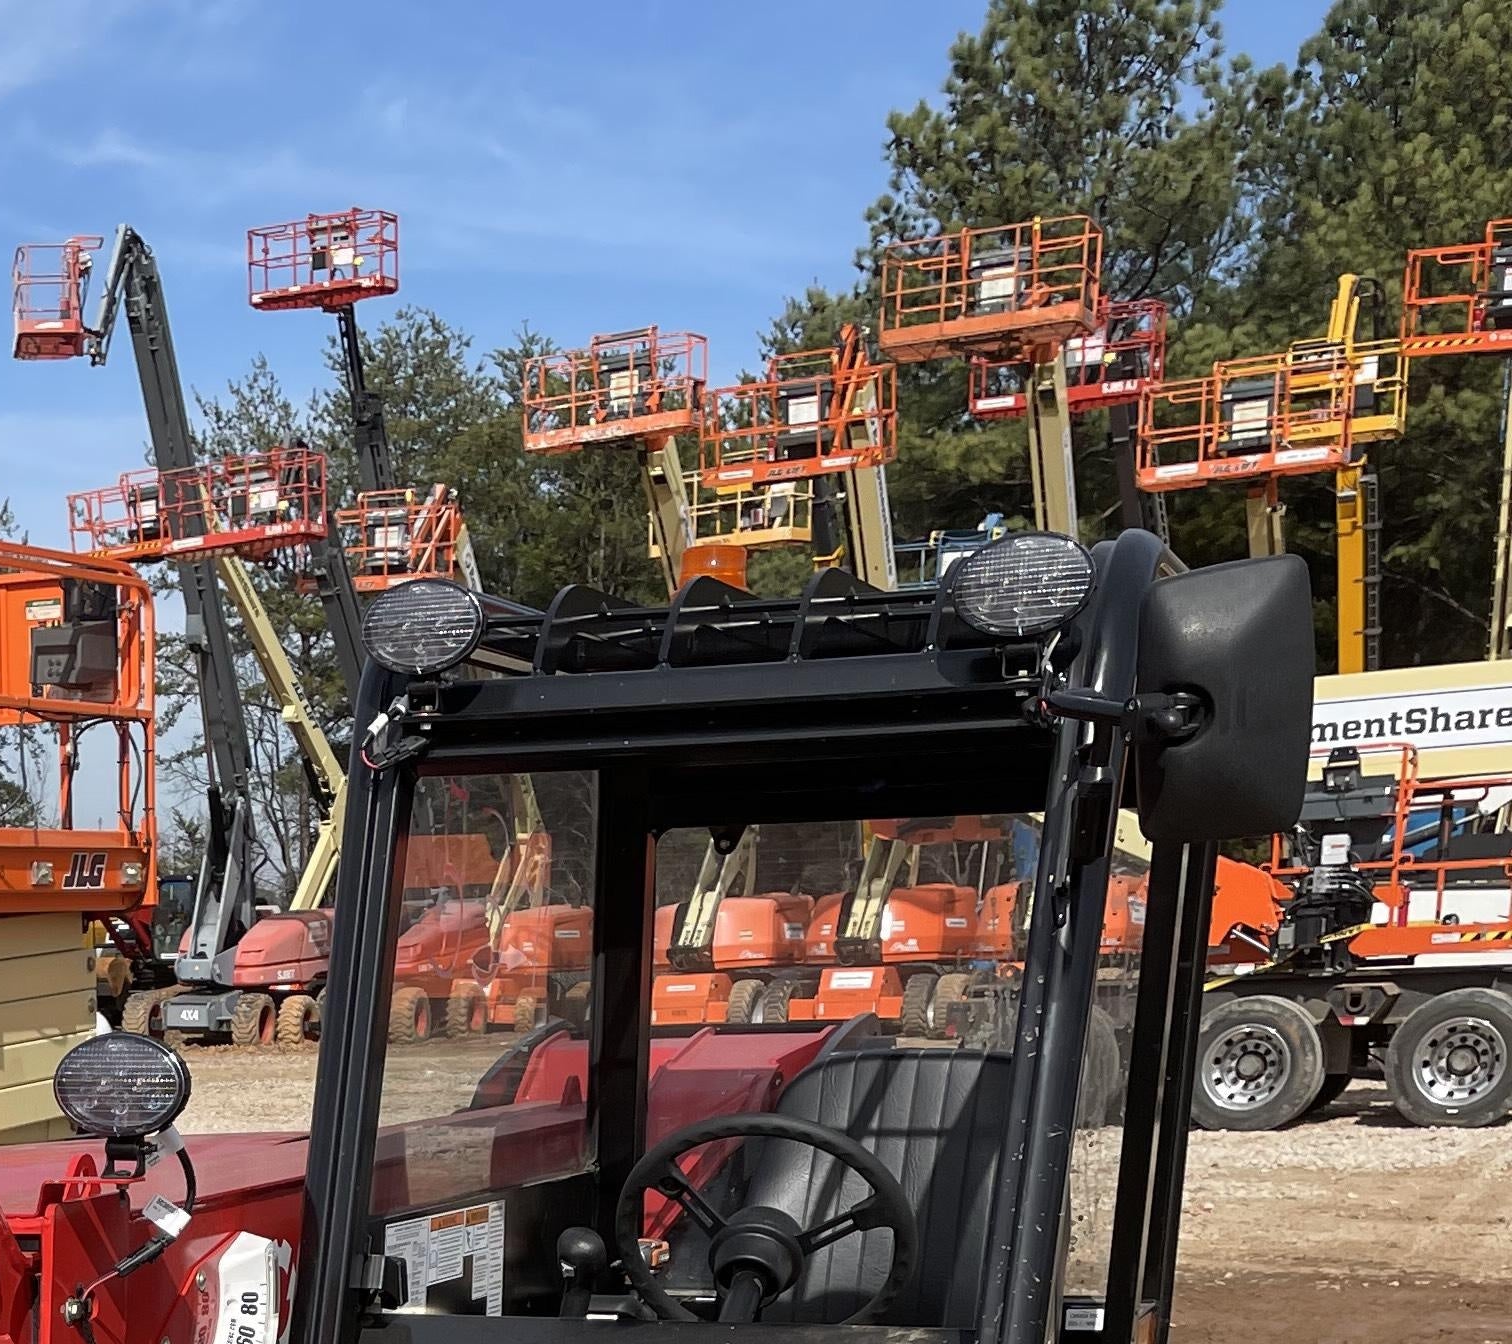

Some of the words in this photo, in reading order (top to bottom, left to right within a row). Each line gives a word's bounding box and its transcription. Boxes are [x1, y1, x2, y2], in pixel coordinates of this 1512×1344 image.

[62, 853, 108, 889] JLG
[180, 1009, 199, 1021] 4X4
[241, 1291, 259, 1316] 80
